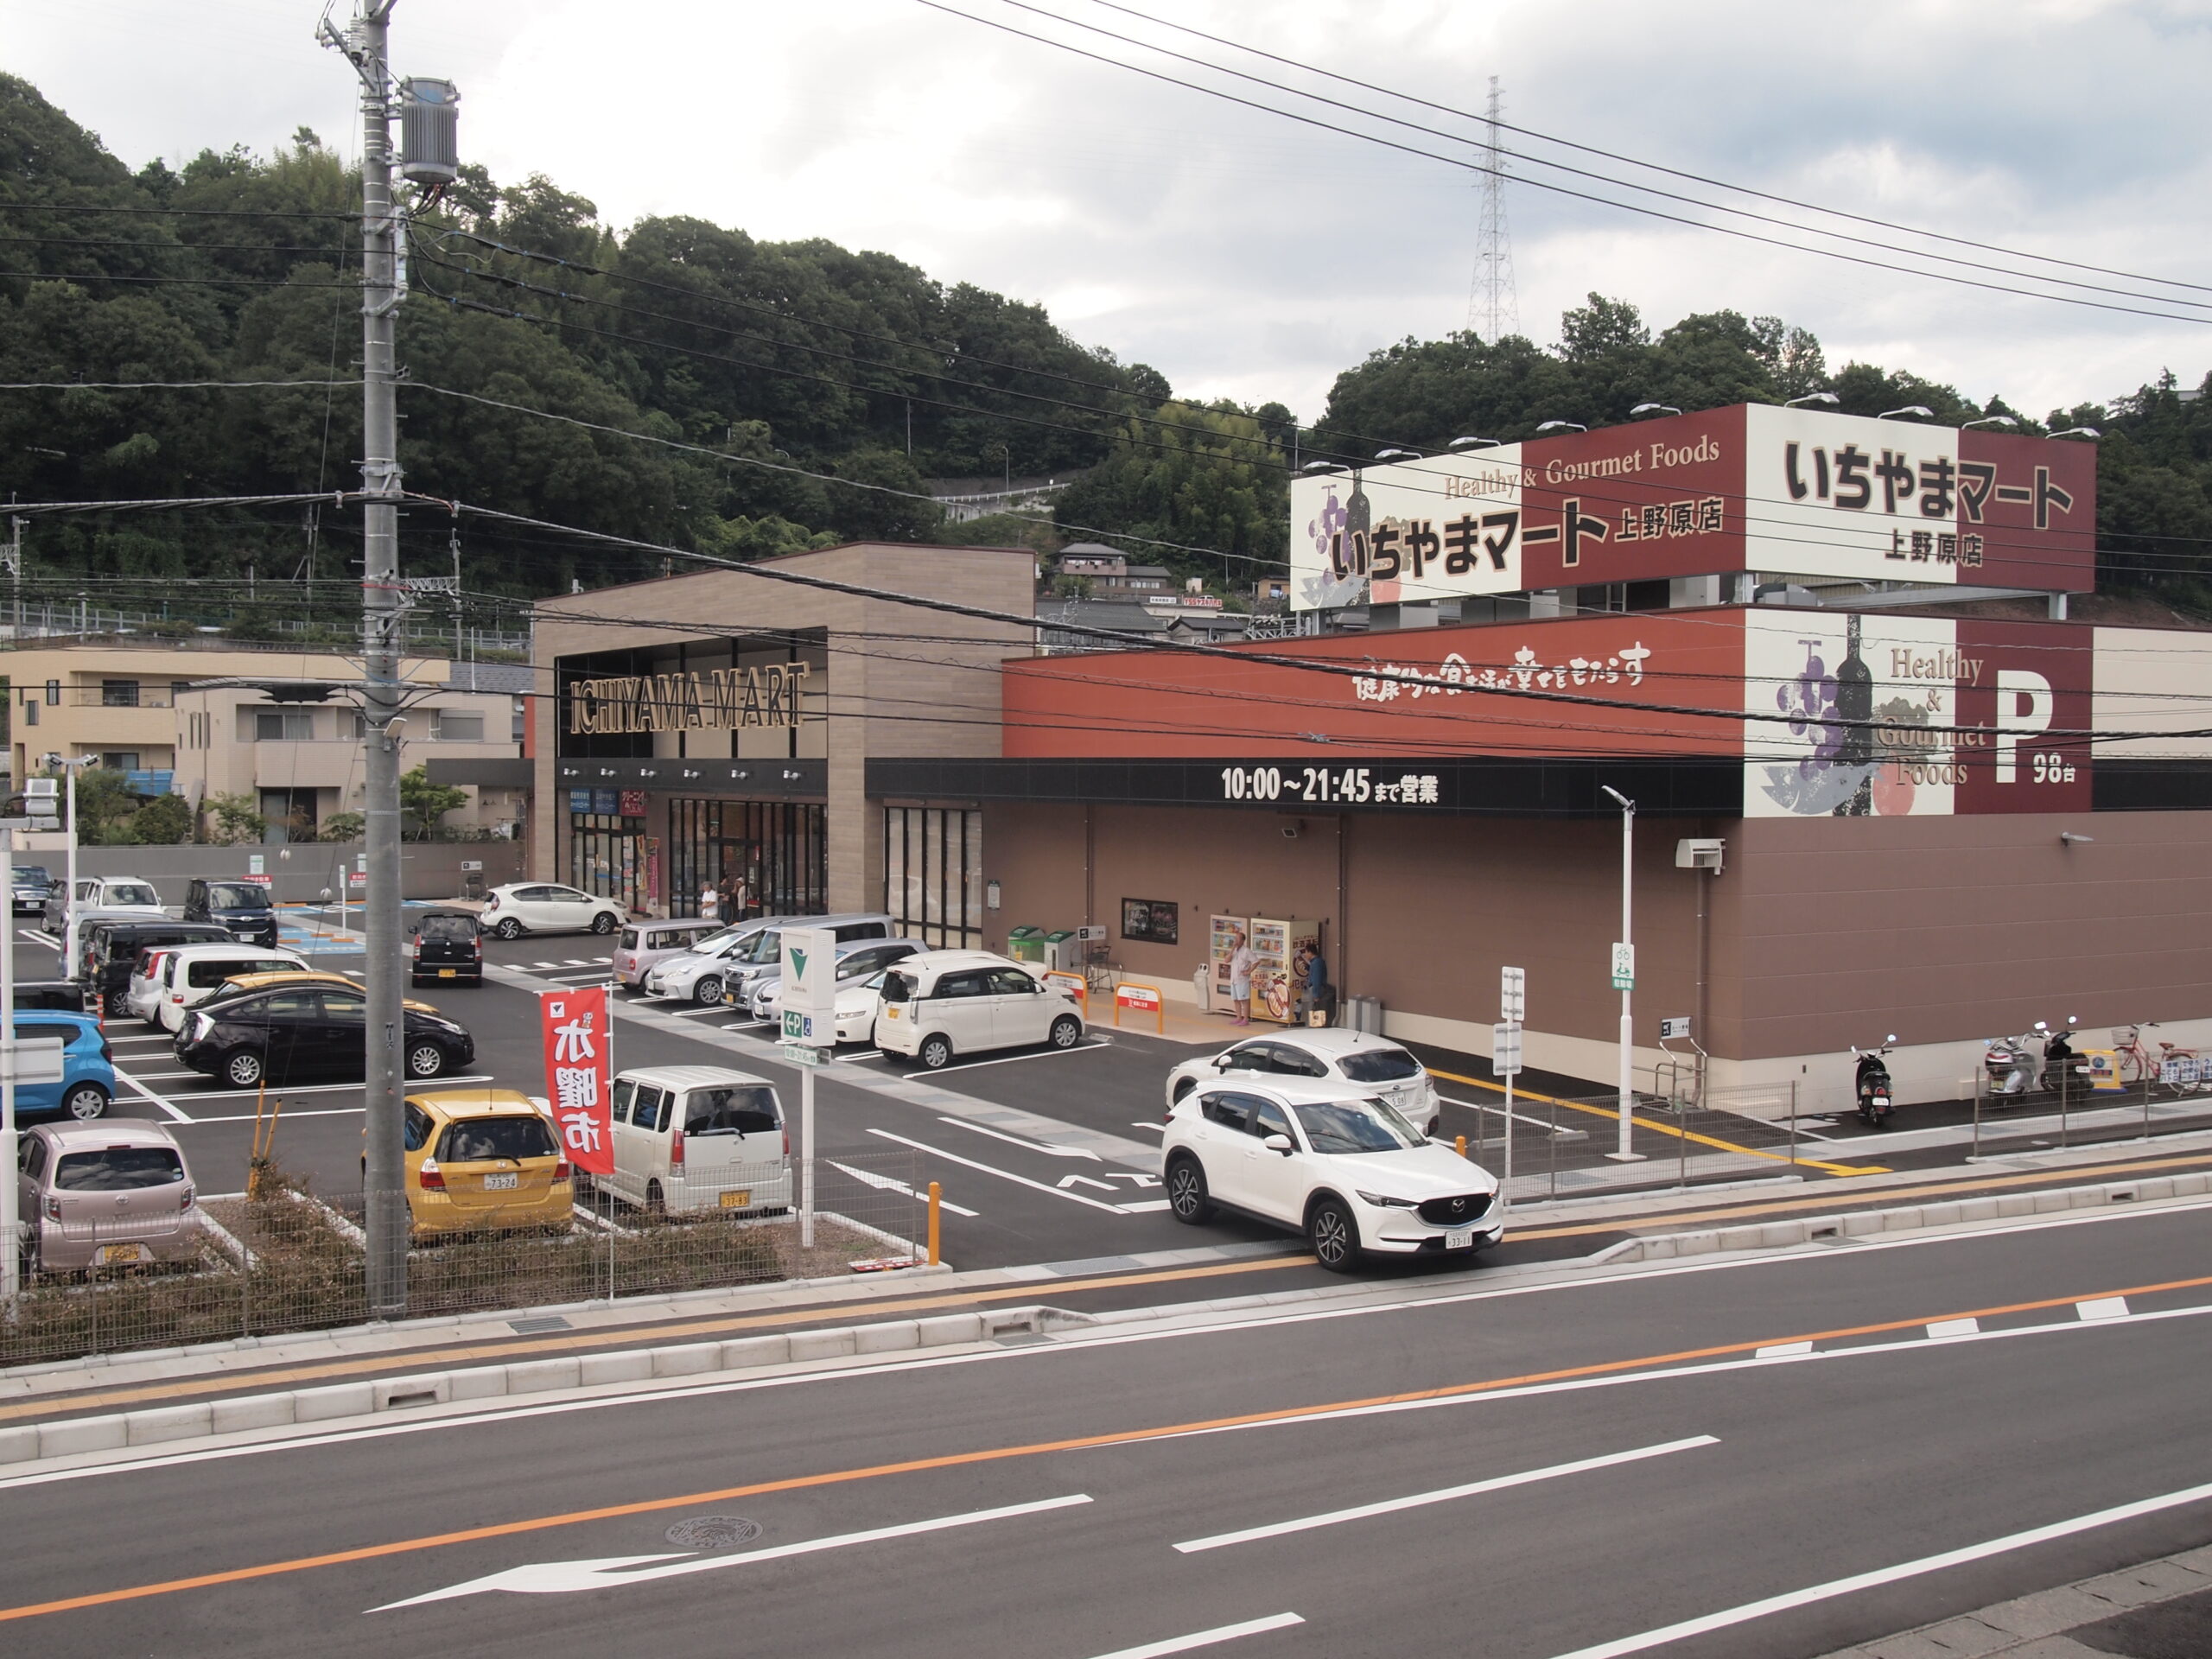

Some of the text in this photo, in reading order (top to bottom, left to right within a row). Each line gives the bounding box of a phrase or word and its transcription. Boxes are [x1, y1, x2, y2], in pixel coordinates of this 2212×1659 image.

[1445, 434, 1720, 501] Healthy & Gourmet Foods
[1784, 441, 2074, 530] いちやまマート
[1332, 496, 1725, 582] いちやまマート 上野原店
[1885, 528, 1984, 568] 上野原店
[1891, 647, 1985, 687] Healthy
[570, 660, 810, 734] ICHIYAMA MART
[1926, 690, 1943, 712] &
[1877, 715, 1986, 747] Gourmet
[1996, 670, 2053, 784] P
[1896, 755, 1968, 785] Foods
[2033, 752, 2076, 784] 98台
